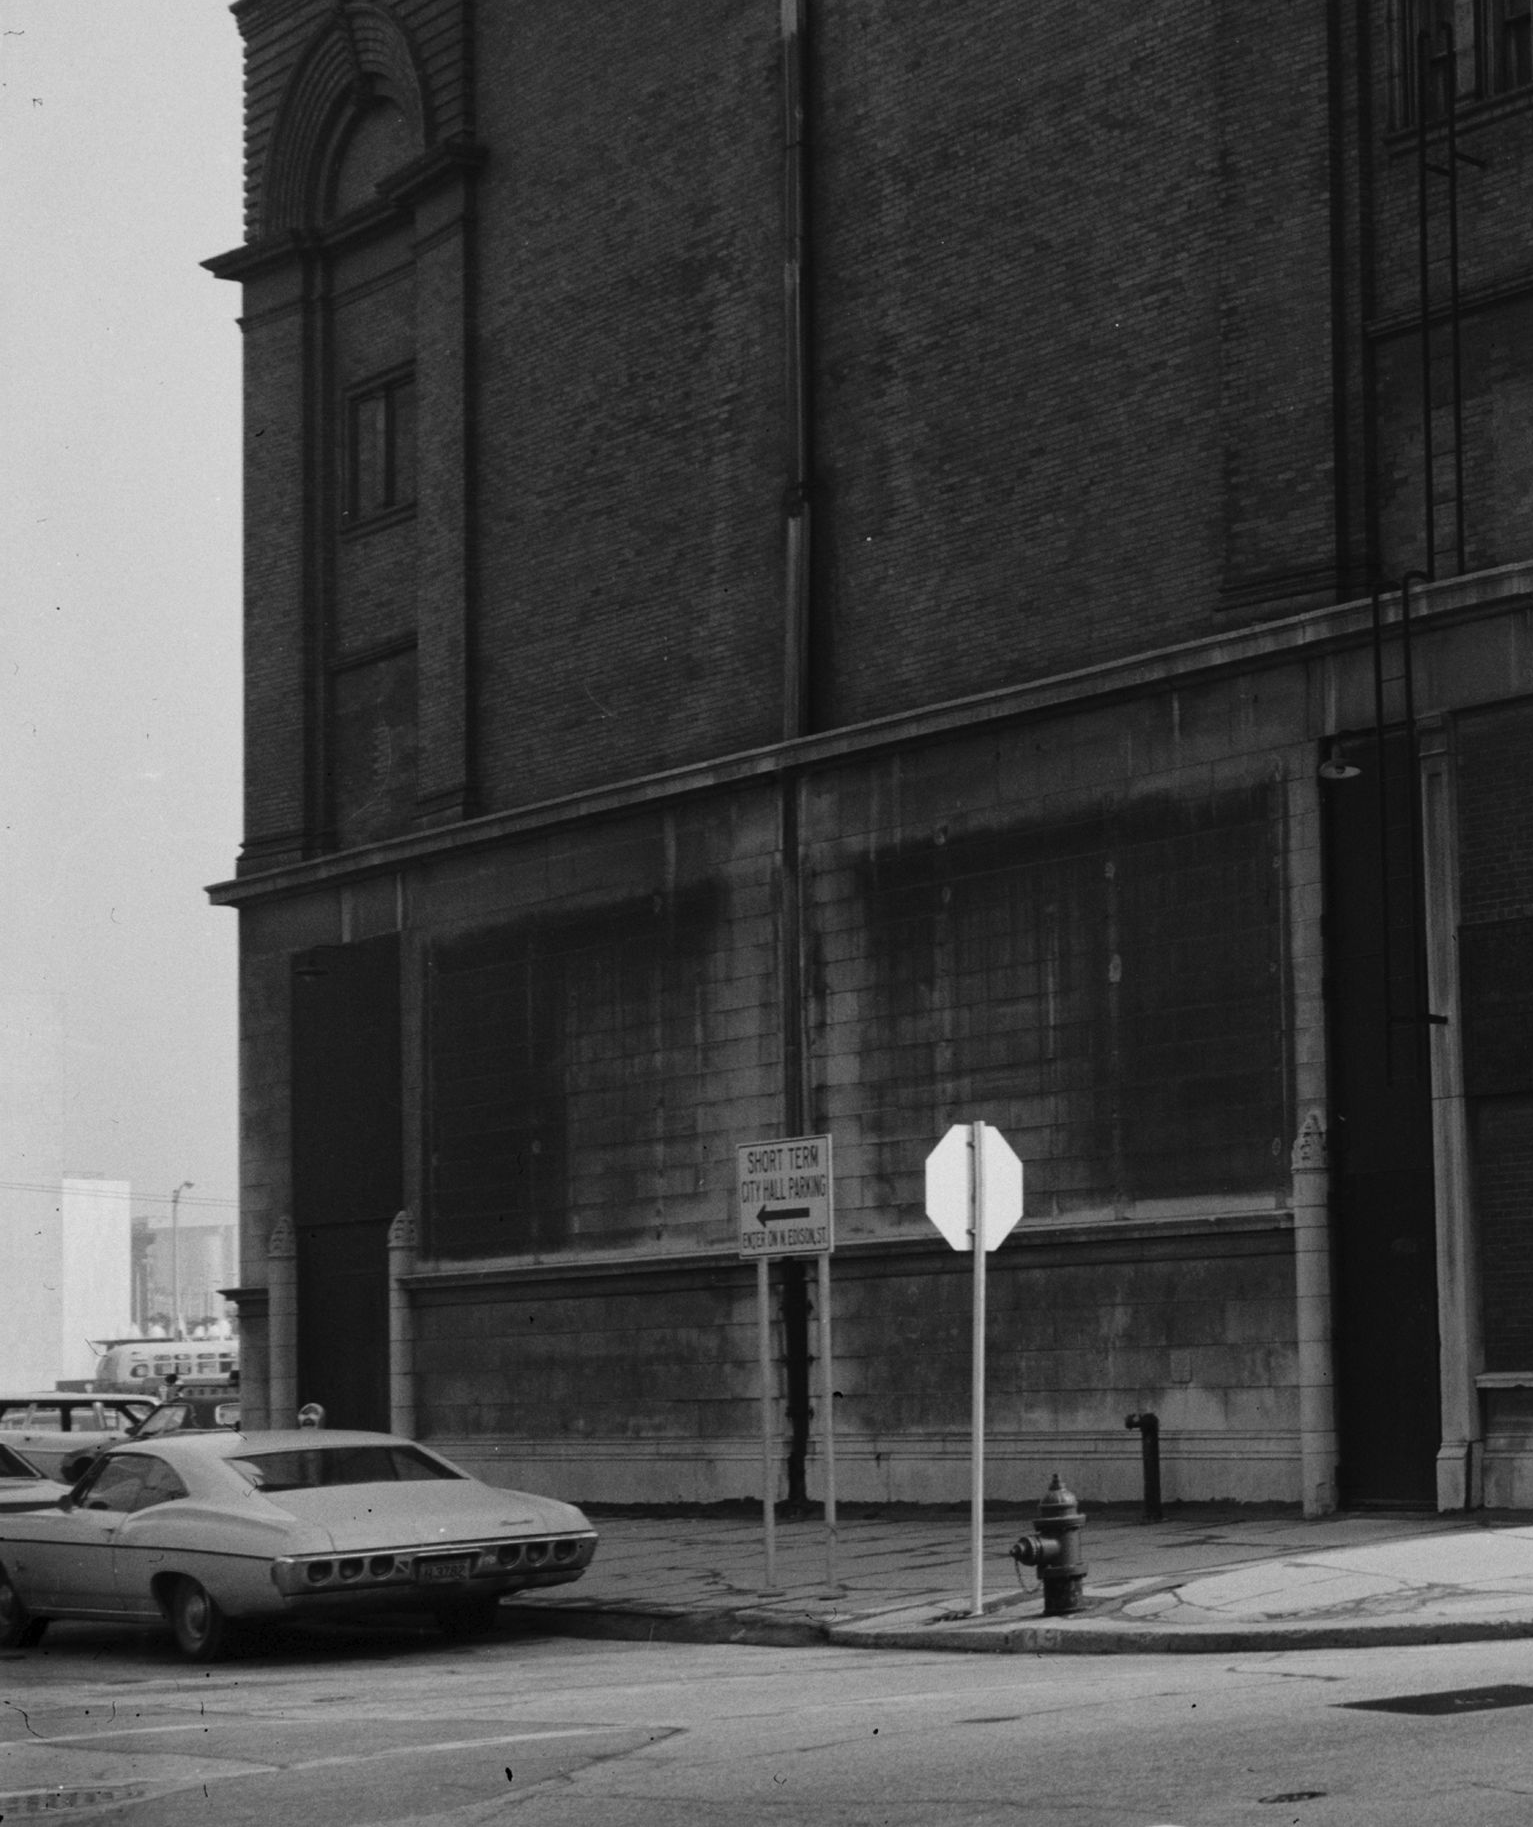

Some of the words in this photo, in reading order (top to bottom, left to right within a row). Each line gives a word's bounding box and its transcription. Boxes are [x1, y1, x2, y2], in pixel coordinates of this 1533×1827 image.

[747, 1148, 782, 1174] SHORT
[788, 1144, 819, 1171] TERM
[742, 1180, 760, 1204] CITY
[763, 1177, 786, 1202] HALL
[788, 1174, 827, 1200] PARKING
[743, 1231, 765, 1249] ENTER
[768, 1230, 778, 1247] ON
